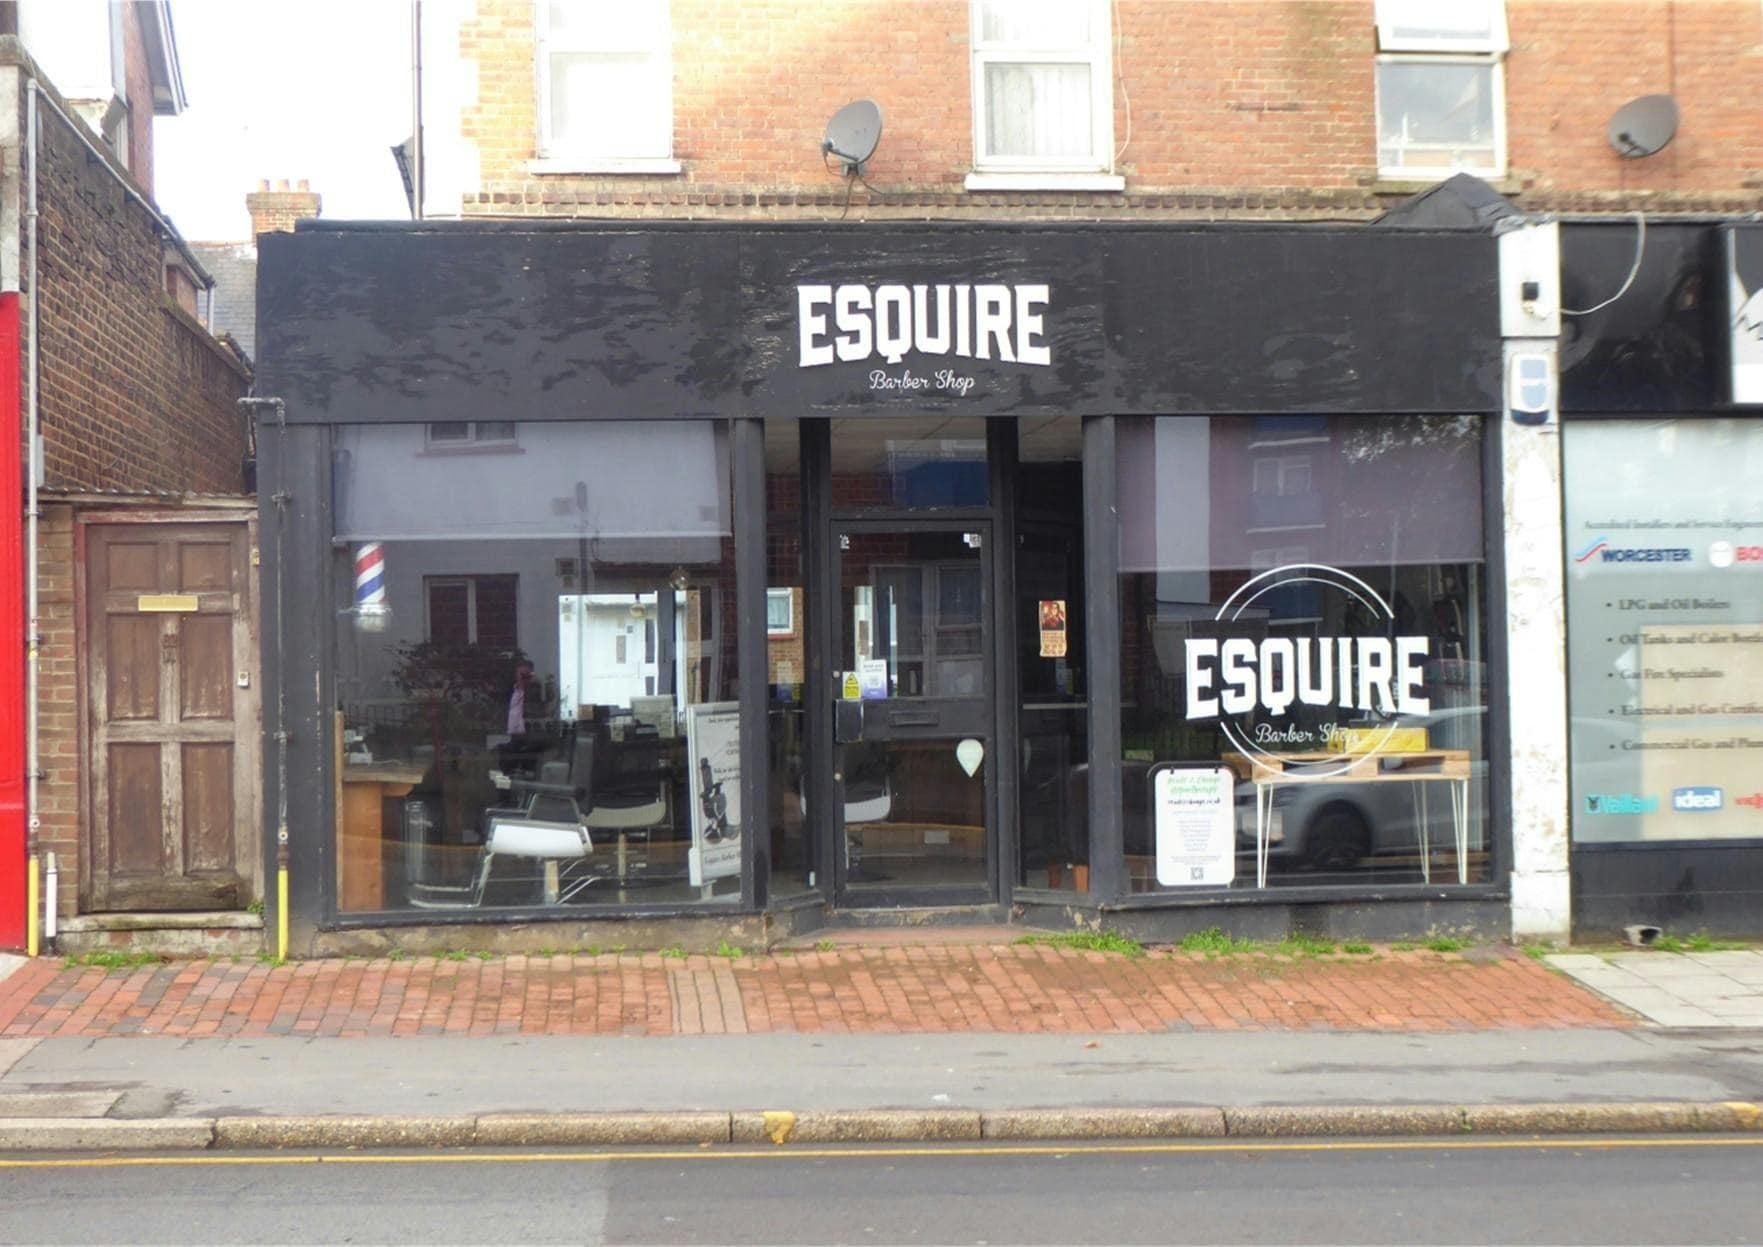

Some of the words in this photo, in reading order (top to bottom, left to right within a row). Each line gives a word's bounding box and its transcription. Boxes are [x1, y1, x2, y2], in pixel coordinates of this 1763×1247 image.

[797, 284, 1050, 367] ESQUIRE
[869, 369, 930, 391] Barber
[935, 369, 976, 397] Shop
[1601, 548, 1692, 562] WORCESTER
[1619, 599, 1646, 610] LPG
[1184, 636, 1430, 719] ESQUIRE
[1255, 722, 1313, 743] Barber
[1319, 722, 1360, 744] Shop
